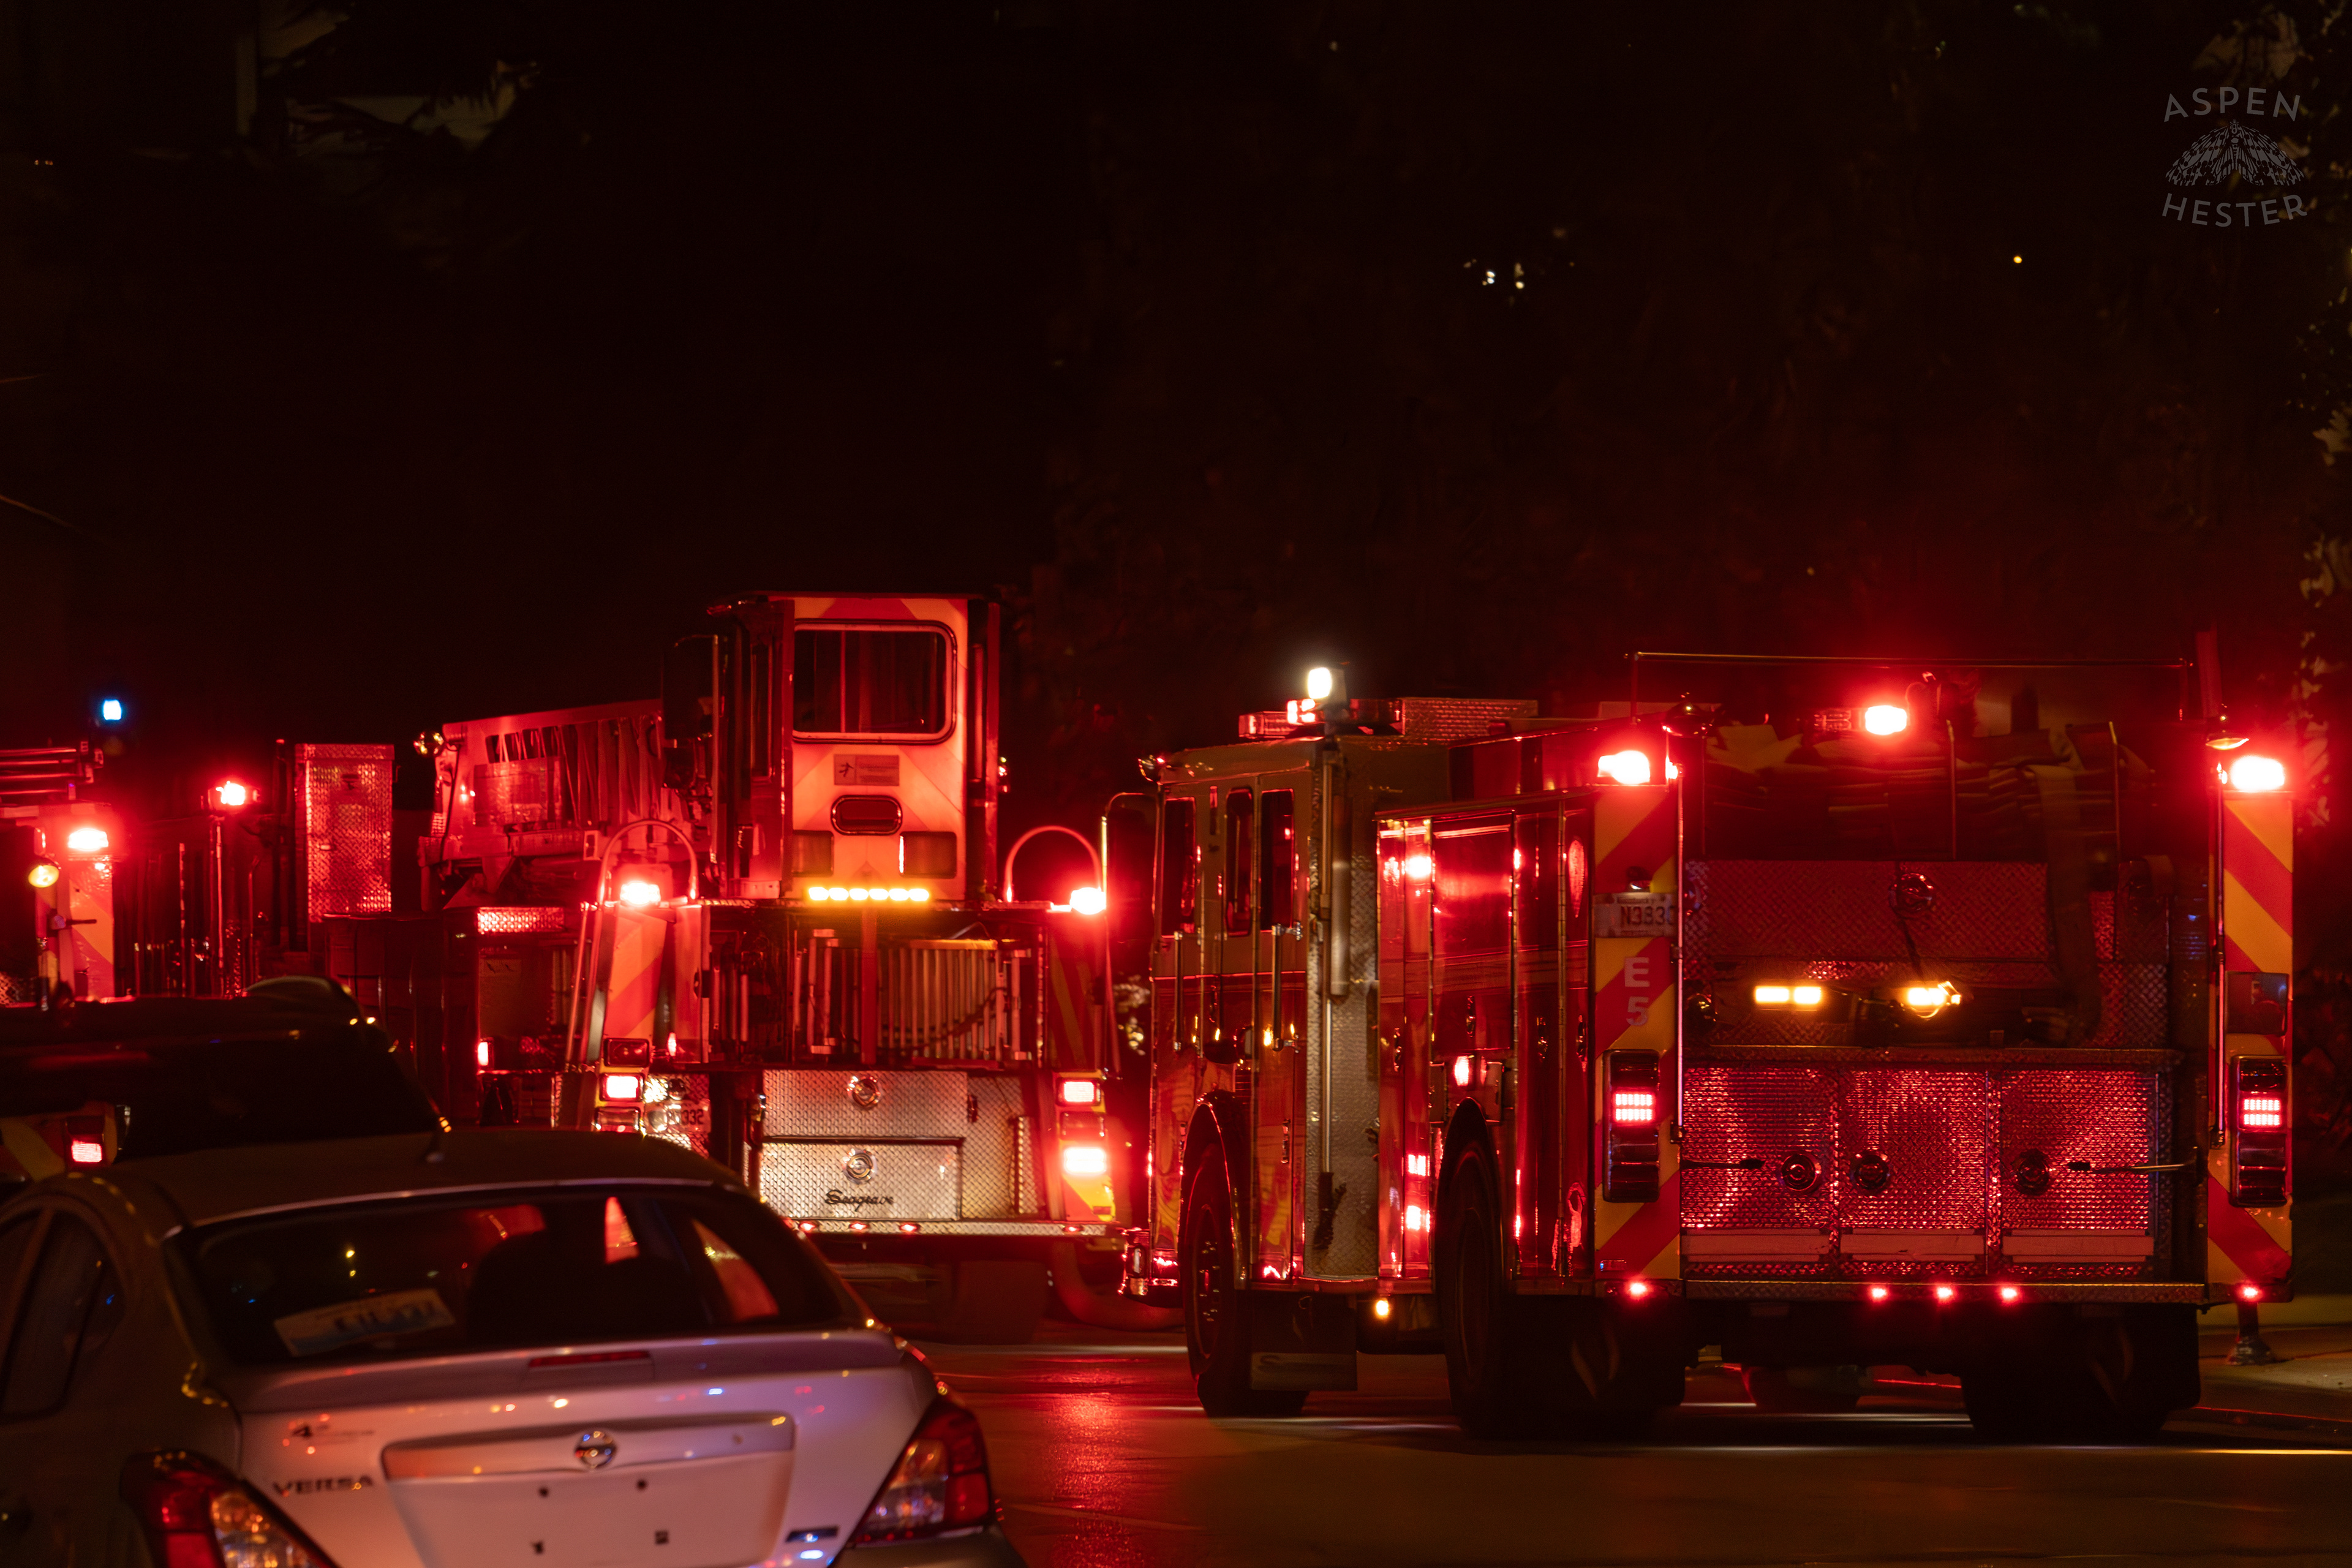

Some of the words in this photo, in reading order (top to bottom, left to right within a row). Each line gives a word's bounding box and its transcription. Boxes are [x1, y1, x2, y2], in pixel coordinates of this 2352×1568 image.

[1624, 956, 1651, 988] E
[1626, 996, 1649, 1027] 5
[825, 1189, 895, 1212] Seagrave
